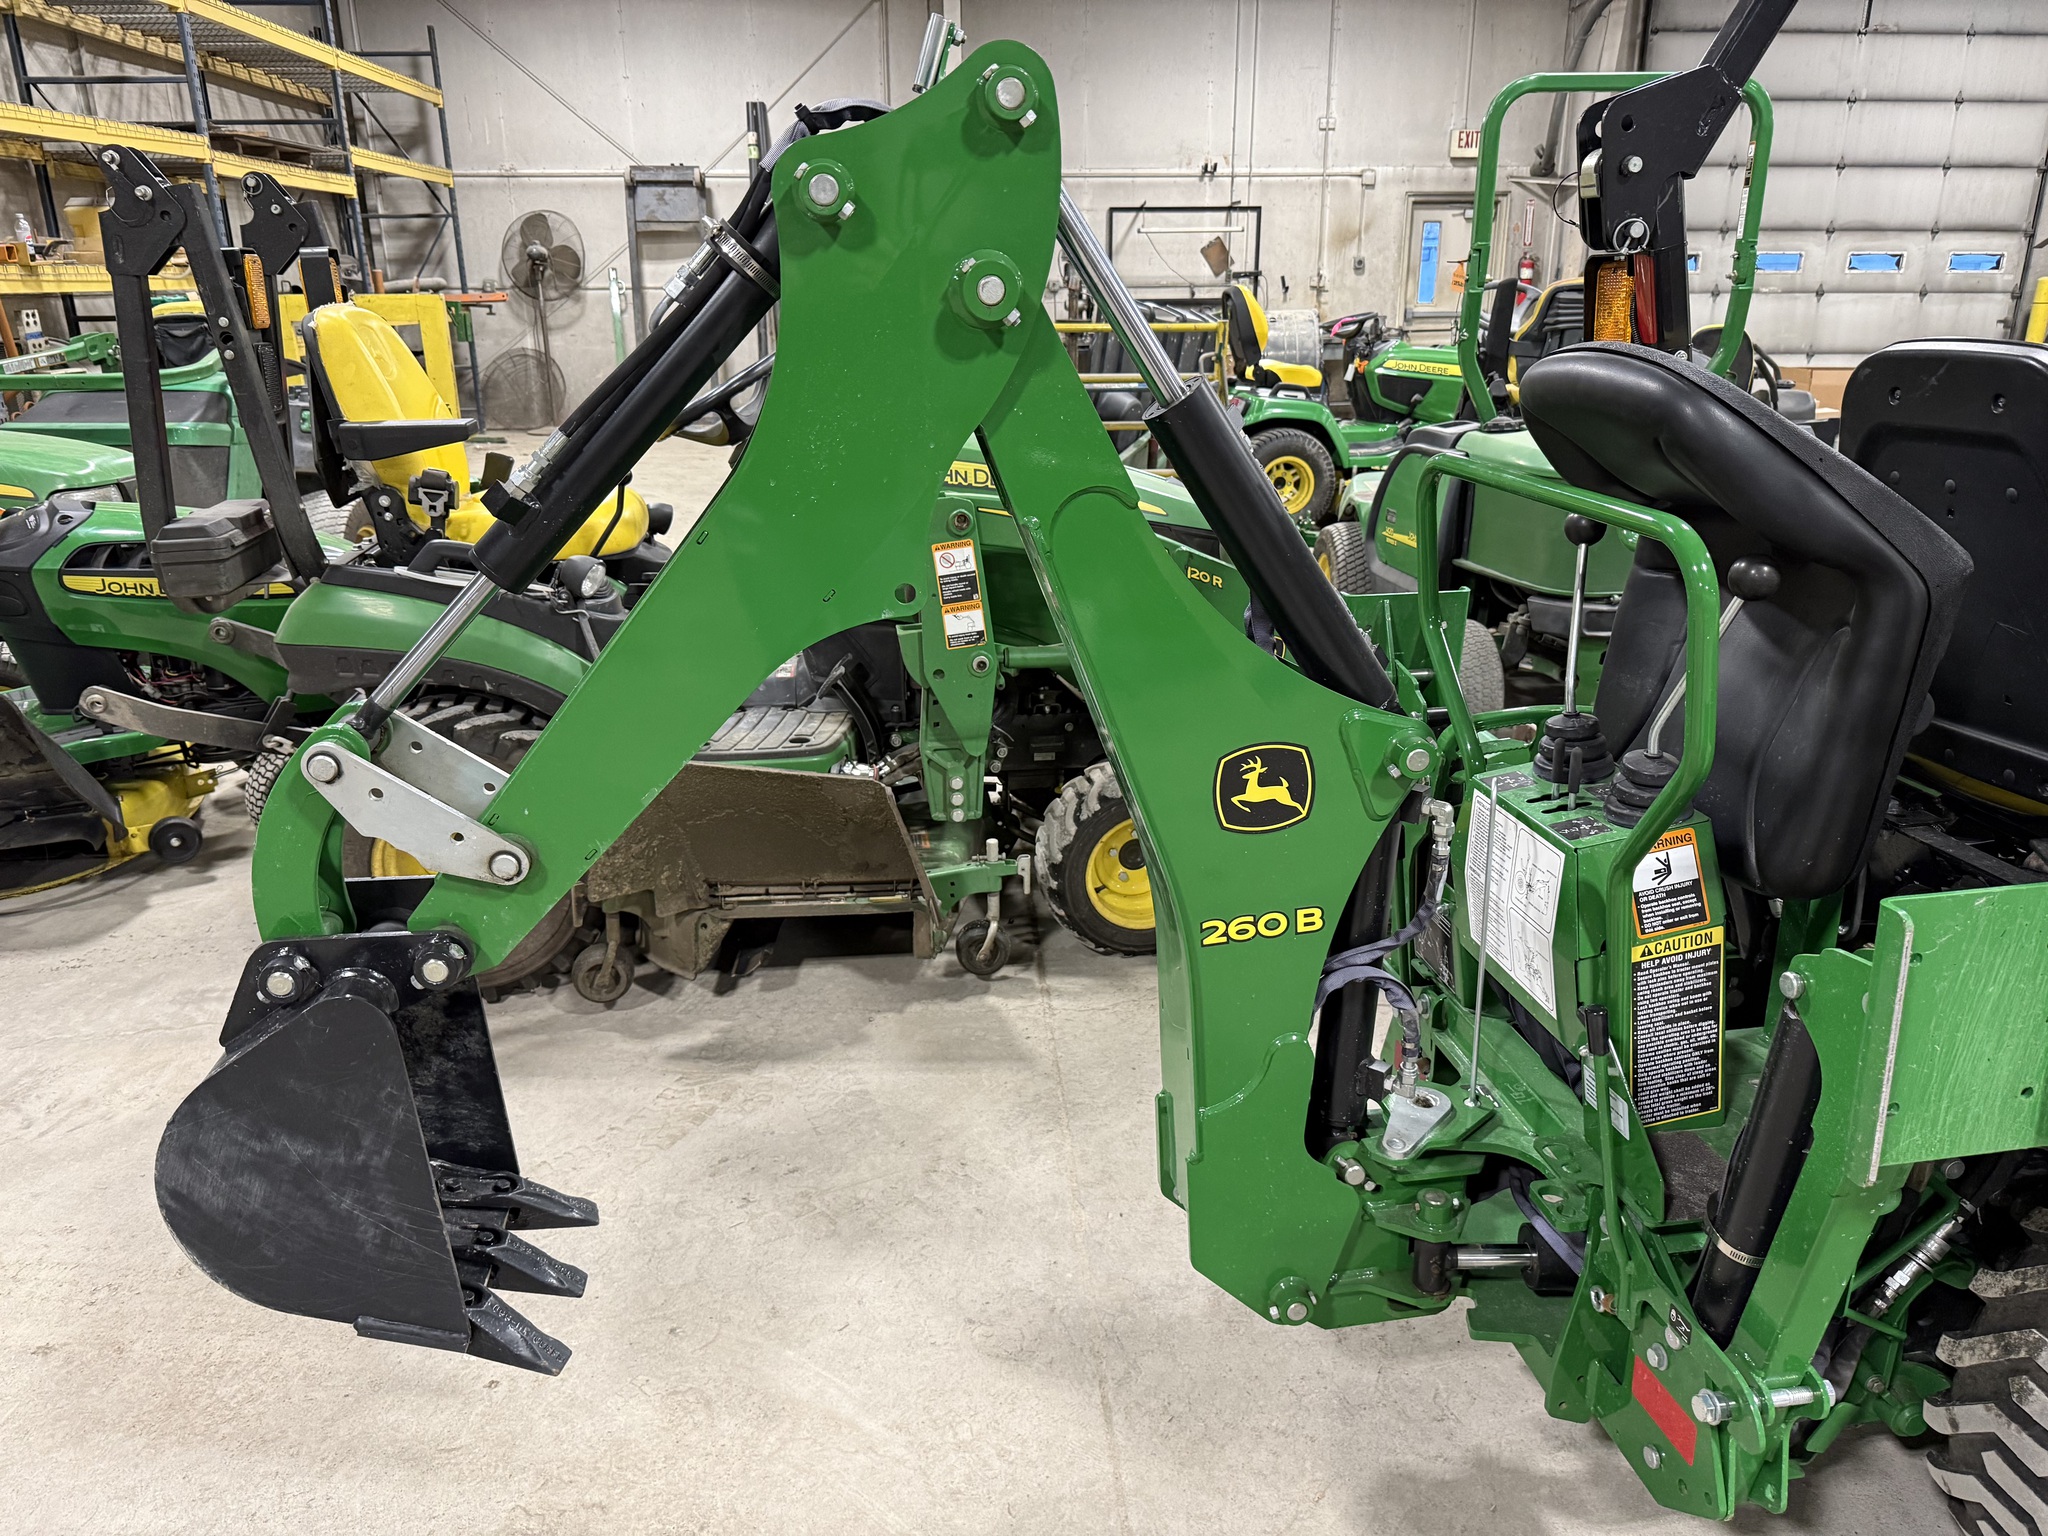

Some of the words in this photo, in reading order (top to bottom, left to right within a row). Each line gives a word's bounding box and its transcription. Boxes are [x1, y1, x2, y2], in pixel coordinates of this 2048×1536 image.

[1458, 130, 1481, 148] EXIT
[1392, 361, 1417, 371] JOHN
[1419, 363, 1449, 374] DEERE
[946, 469, 968, 484] HN
[940, 540, 971, 551] WARNING
[96, 578, 154, 594] JOHN
[1212, 574, 1223, 588] R
[950, 602, 981, 613] WARNING
[1653, 833, 1692, 850] RNING
[1201, 911, 1289, 946] 260
[1294, 906, 1325, 935] B
[1654, 931, 1713, 955] CAUTION
[1641, 959, 1660, 969] HELP
[1662, 954, 1683, 964] AVOID
[1685, 948, 1711, 959] INJURY
